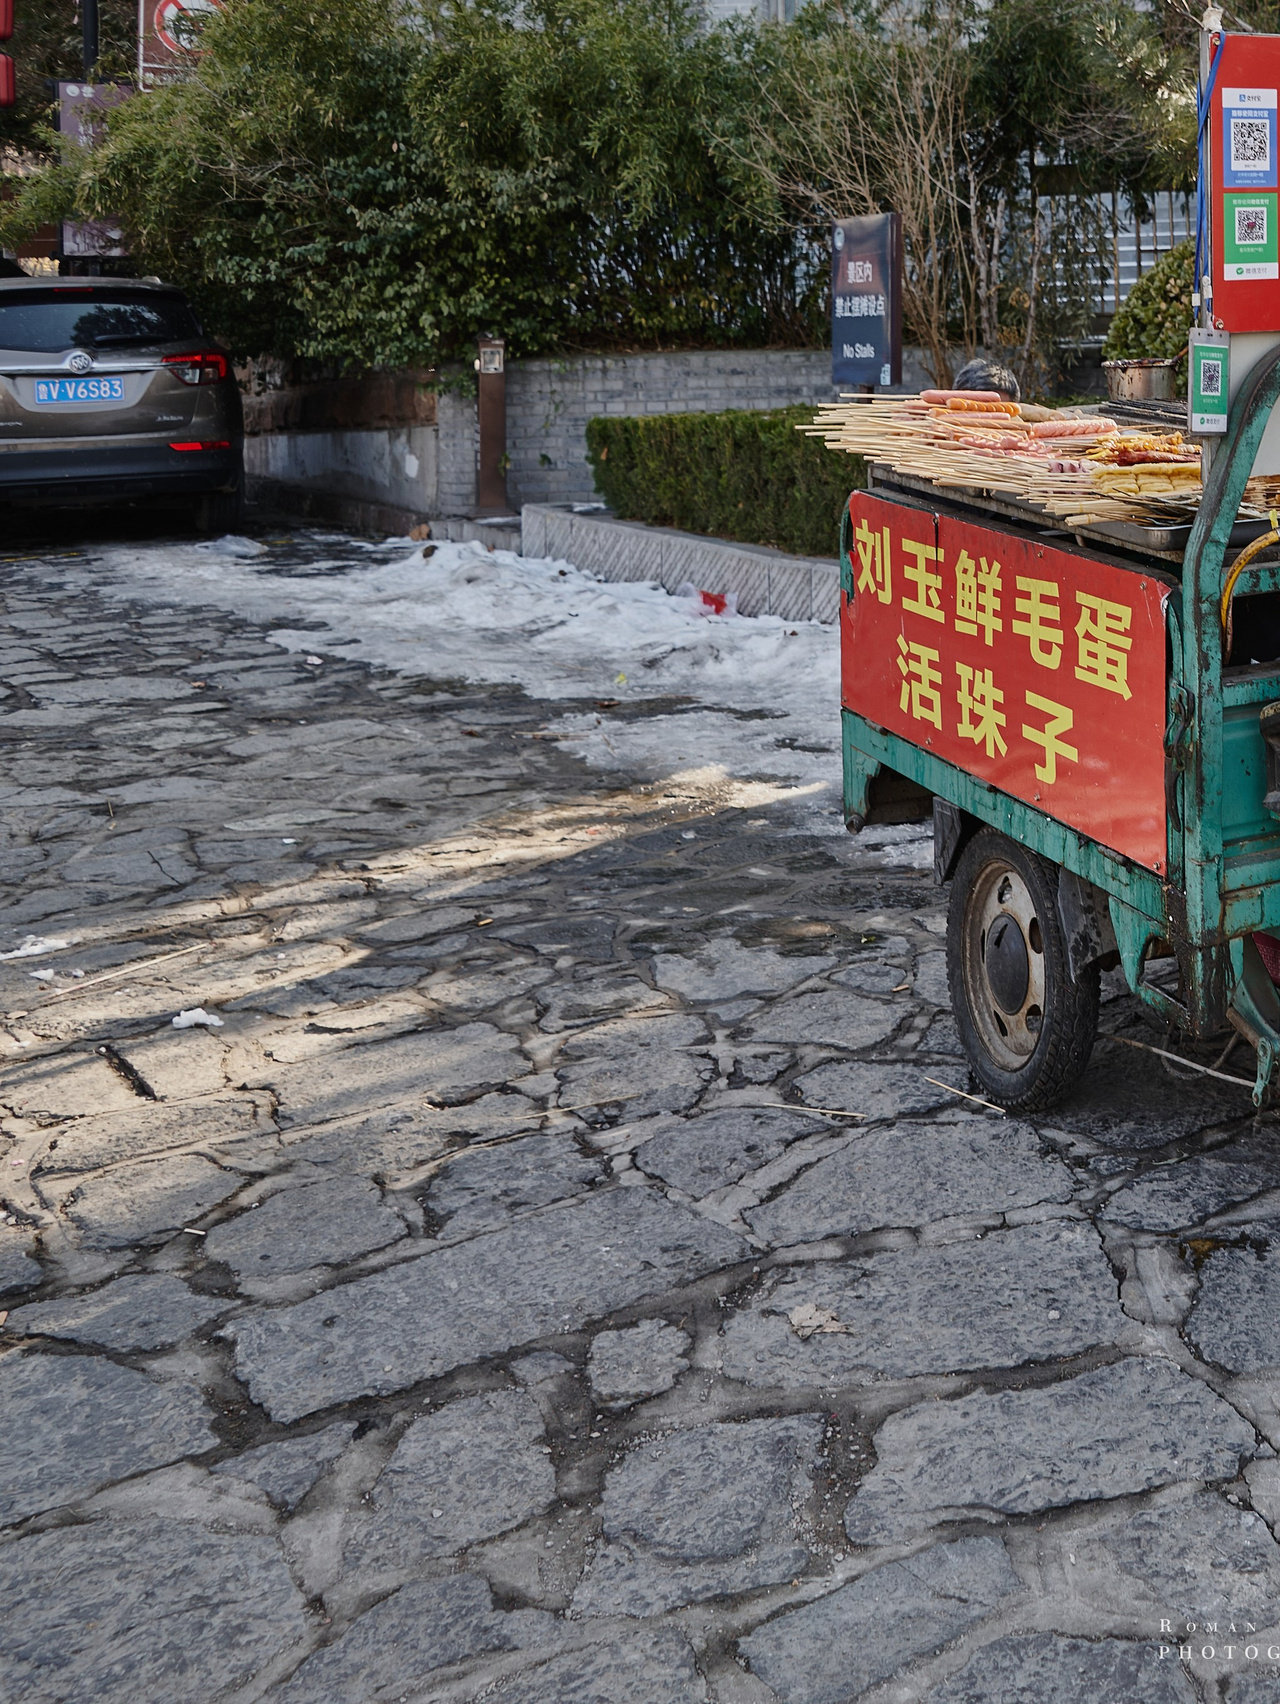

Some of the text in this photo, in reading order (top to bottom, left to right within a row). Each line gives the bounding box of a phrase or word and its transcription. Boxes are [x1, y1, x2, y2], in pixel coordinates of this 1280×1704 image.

[847, 260, 873, 284] 景区内
[835, 293, 886, 319] 禁止摆摊设点
[843, 342, 875, 359] No Stalls
[855, 518, 1133, 701] 刘玉鲜毛蛋
[896, 634, 1080, 785] 活珠子
